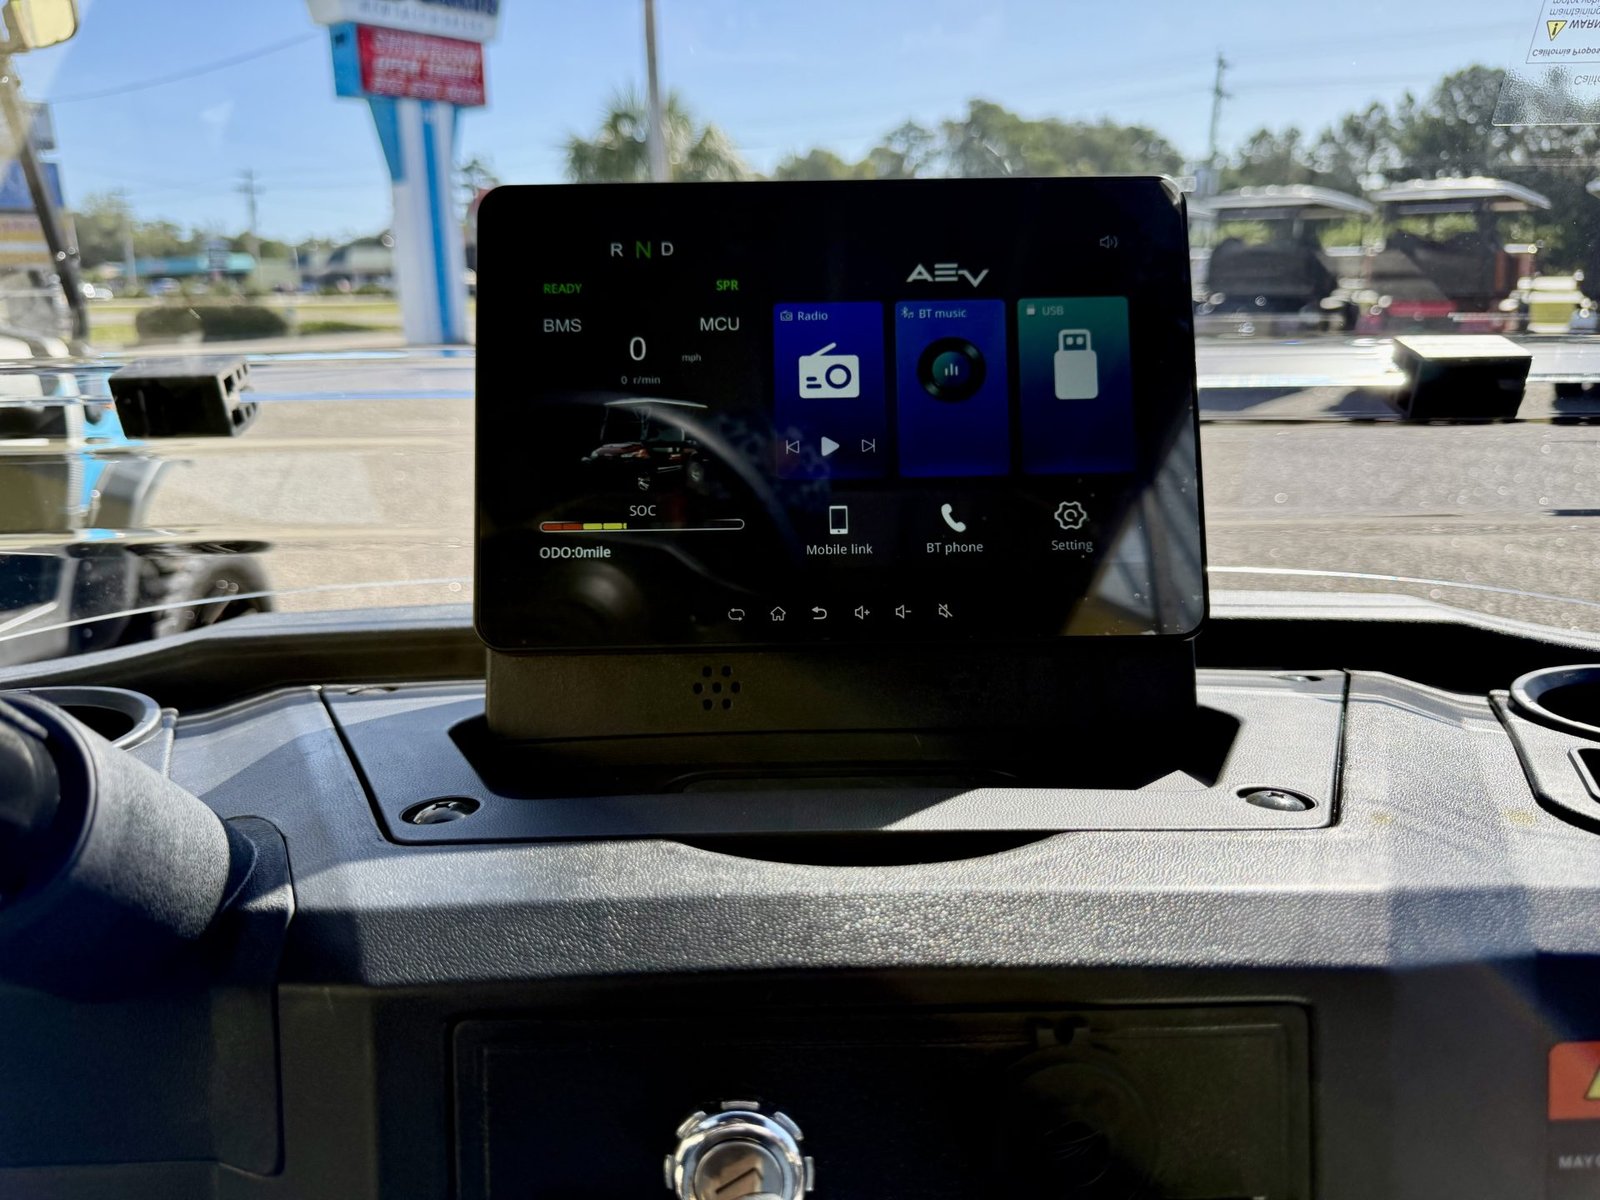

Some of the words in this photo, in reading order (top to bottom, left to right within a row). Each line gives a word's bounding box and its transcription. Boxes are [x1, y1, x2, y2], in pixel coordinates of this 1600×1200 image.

[610, 242, 623, 257] R
[635, 241, 651, 259] N
[661, 241, 674, 256] D
[543, 283, 582, 294] READY
[716, 279, 739, 291] SPR
[797, 310, 829, 321] Radio
[919, 308, 932, 319] BT
[934, 308, 967, 319] music
[1041, 305, 1064, 316] USB
[543, 318, 582, 333] BMS
[700, 317, 740, 331] MCU
[629, 336, 647, 361] 0
[682, 353, 702, 364] mph
[620, 375, 628, 385] 0
[633, 375, 661, 385] r/min
[629, 504, 657, 517] SOC
[539, 546, 612, 559] ODO:0mile
[806, 543, 848, 555] Mobile
[851, 543, 873, 555] link
[926, 542, 941, 553] BT
[944, 541, 984, 555] phone
[1051, 539, 1094, 553] Setting
